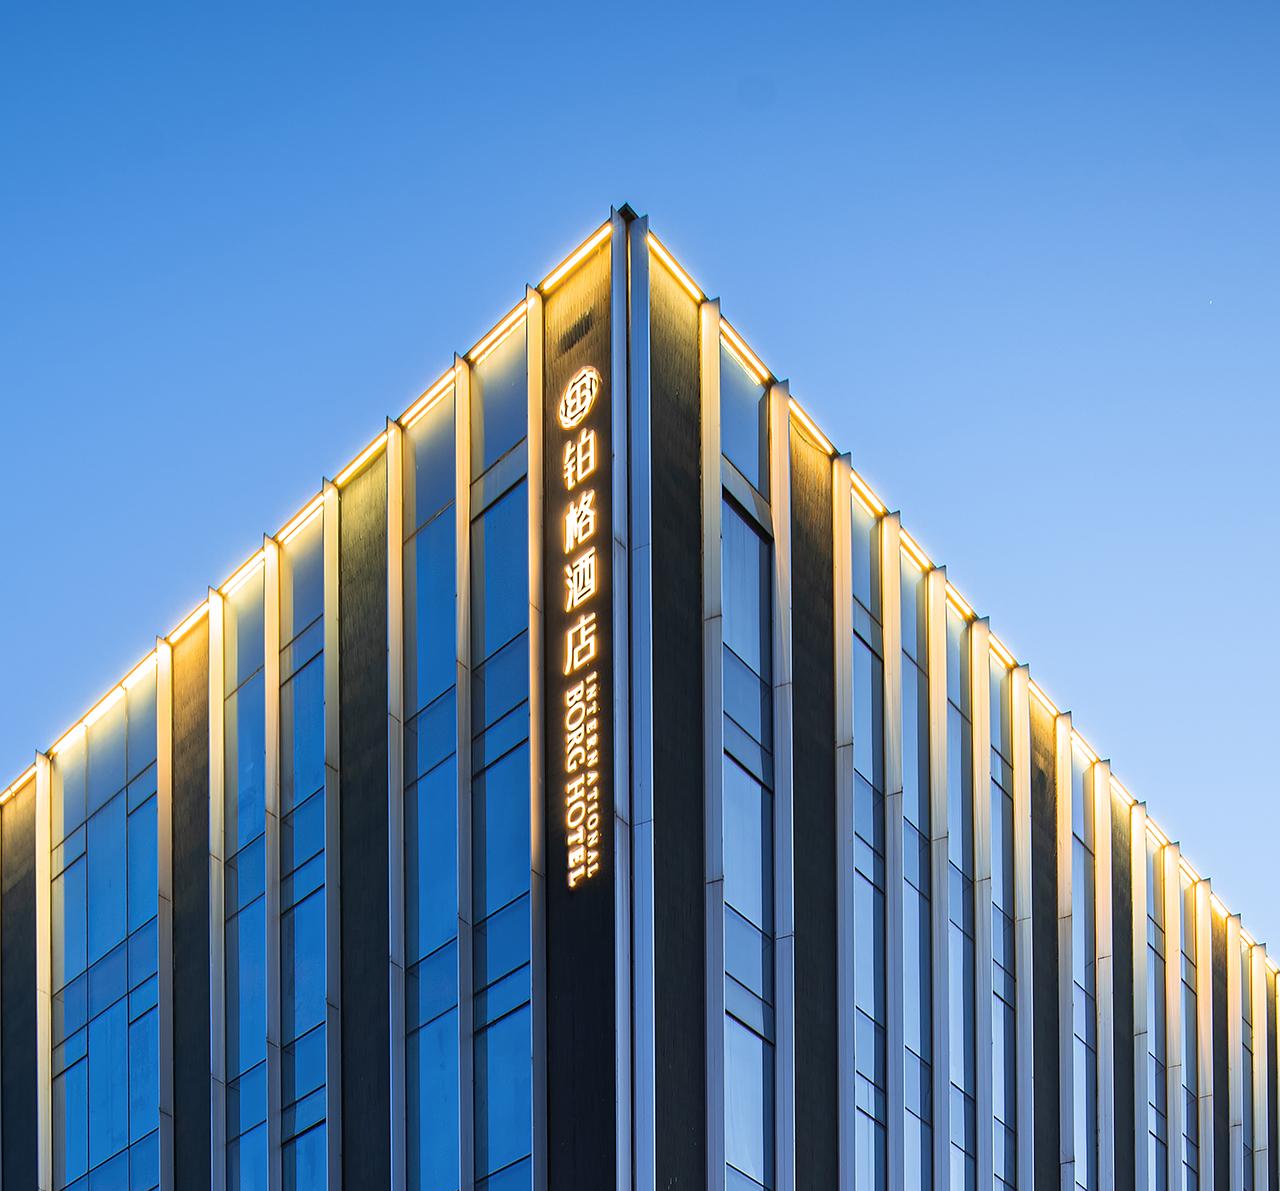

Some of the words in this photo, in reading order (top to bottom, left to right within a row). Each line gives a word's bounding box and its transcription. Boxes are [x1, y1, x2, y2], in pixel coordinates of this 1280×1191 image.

[563, 428, 597, 676] 铂格酒店
[565, 679, 586, 773] BORG
[585, 670, 601, 880] INTERNATIONAL
[566, 772, 587, 889] HOTEL
